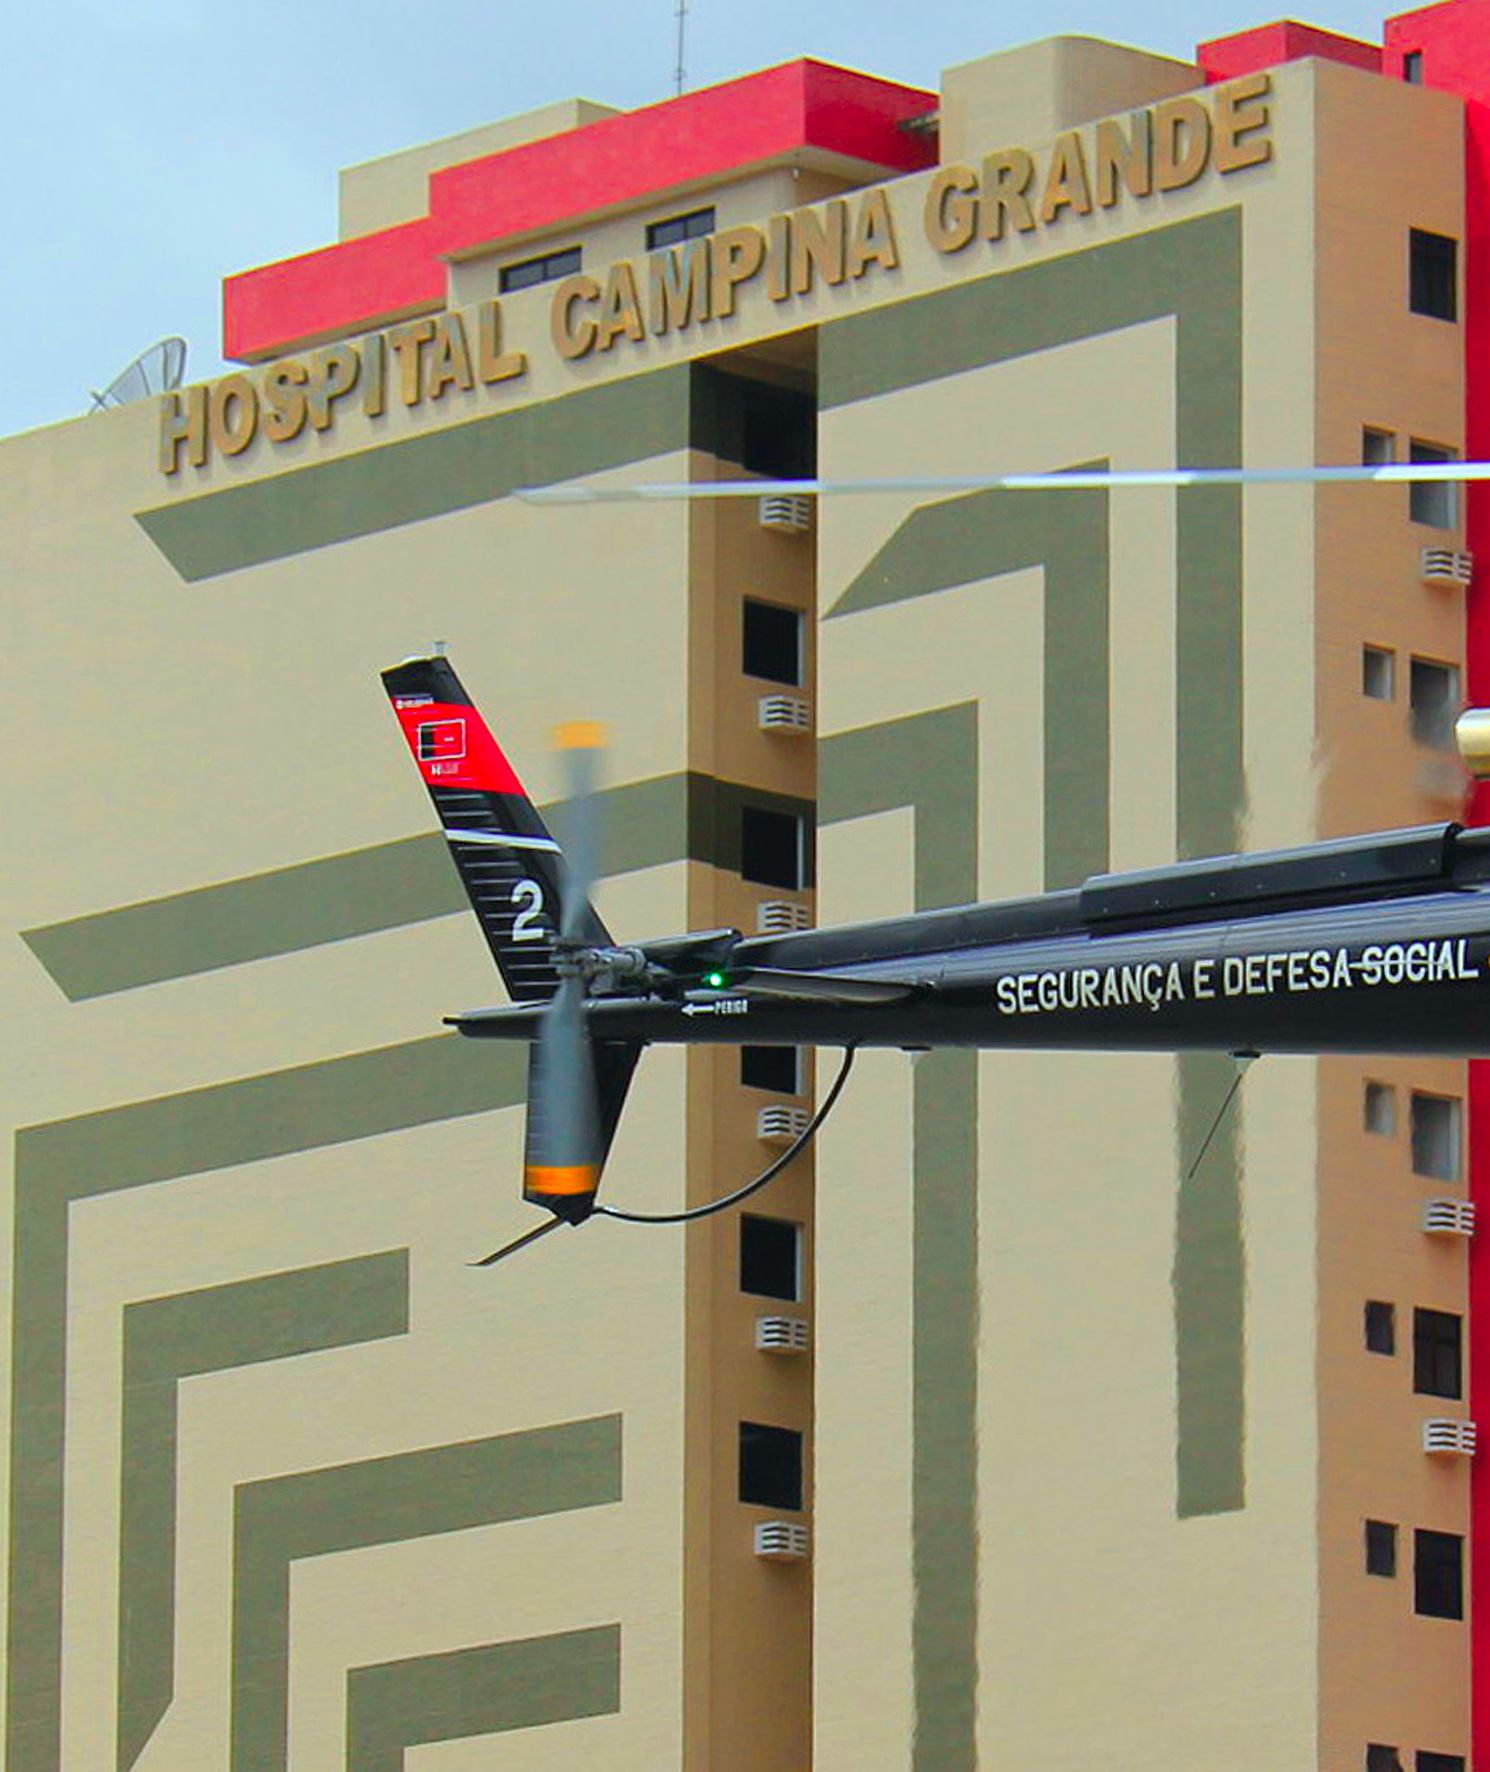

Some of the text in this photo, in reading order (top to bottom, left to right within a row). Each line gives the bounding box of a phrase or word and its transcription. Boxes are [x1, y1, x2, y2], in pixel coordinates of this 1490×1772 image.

[158, 74, 1273, 474] HOSPITAL CAMPINA GRANDE
[510, 880, 544, 942] 2
[996, 939, 1479, 1014] SEGURANÇA E DEFESA SOCIAL
